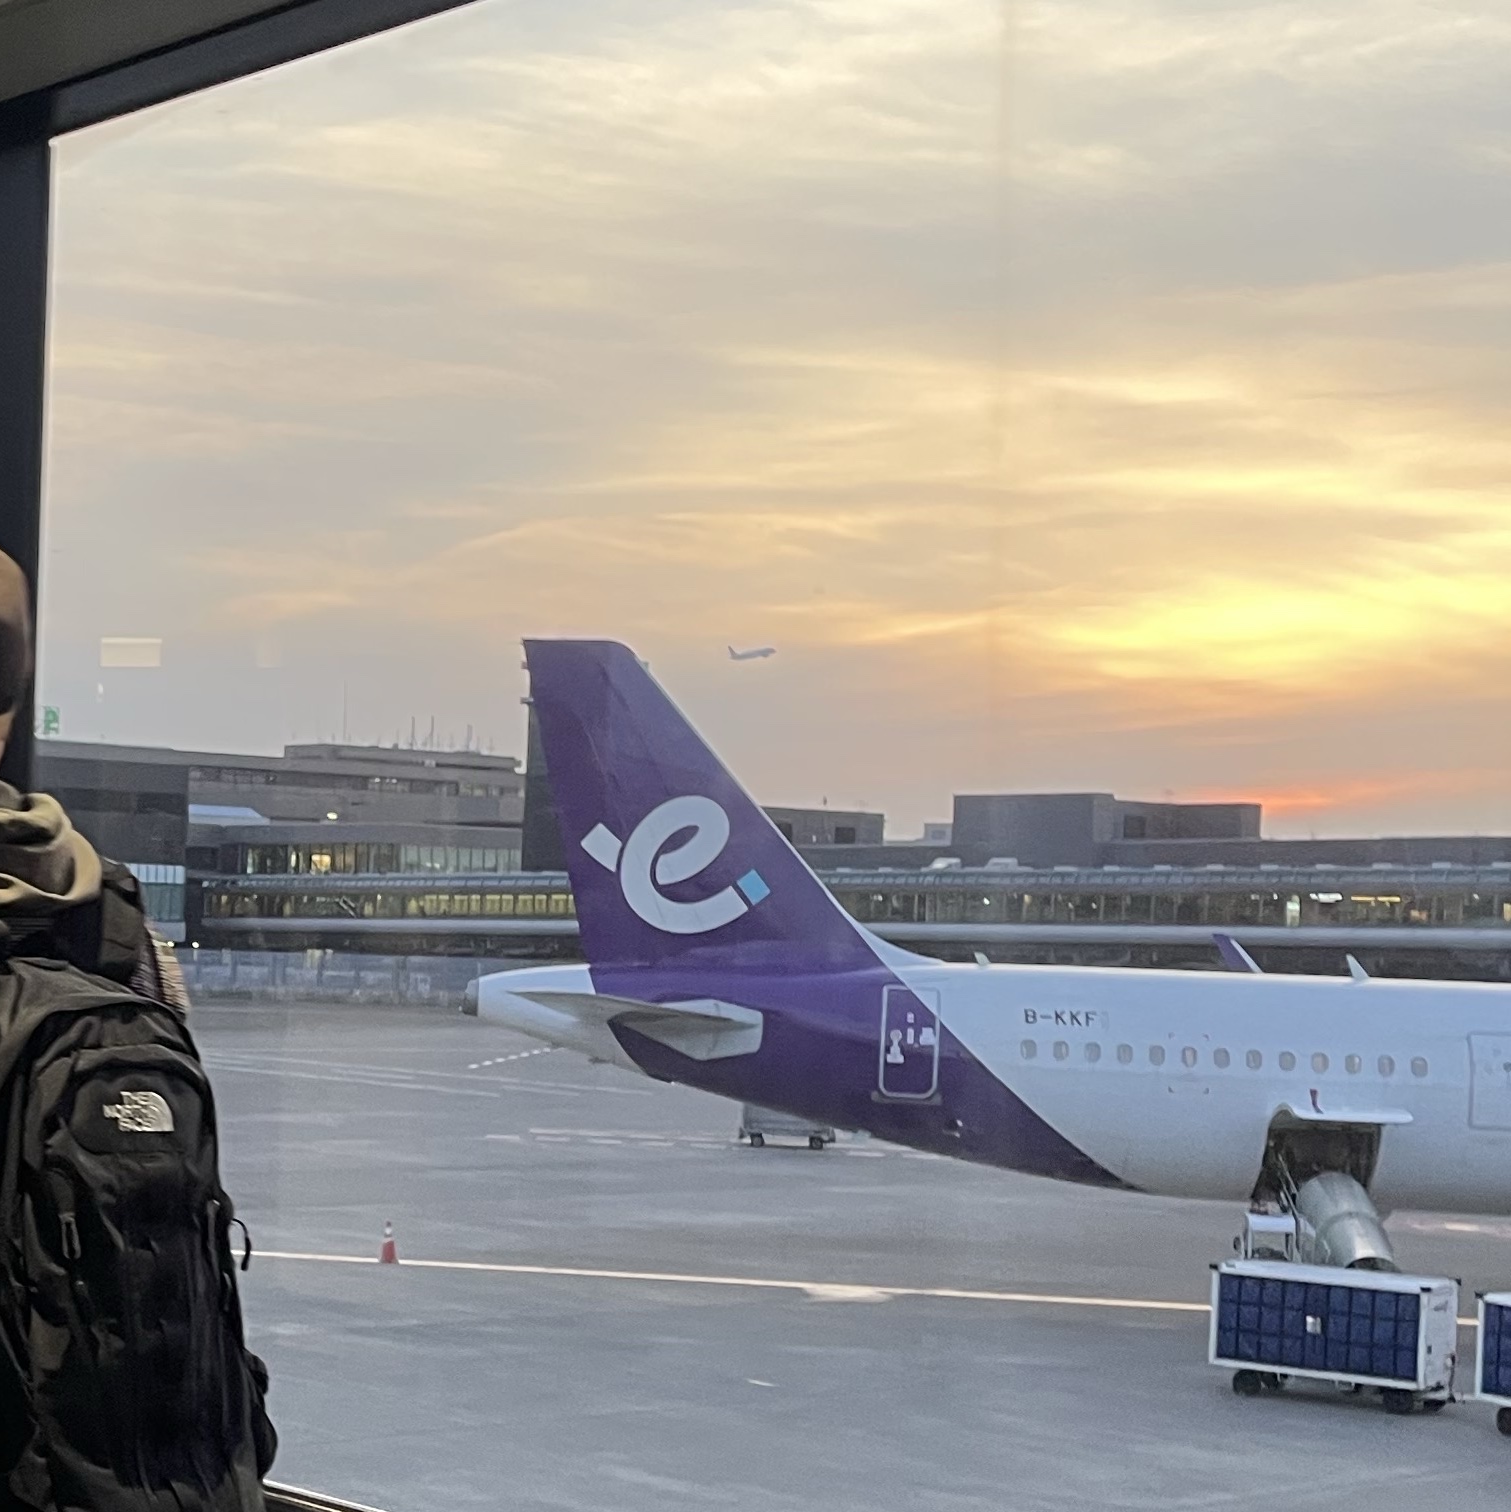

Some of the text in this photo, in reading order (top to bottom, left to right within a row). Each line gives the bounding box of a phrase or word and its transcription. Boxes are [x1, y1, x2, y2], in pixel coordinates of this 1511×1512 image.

[1023, 1008, 1097, 1027] B-KKF
[120, 1091, 149, 1105] THE
[102, 1104, 149, 1120] NORTH
